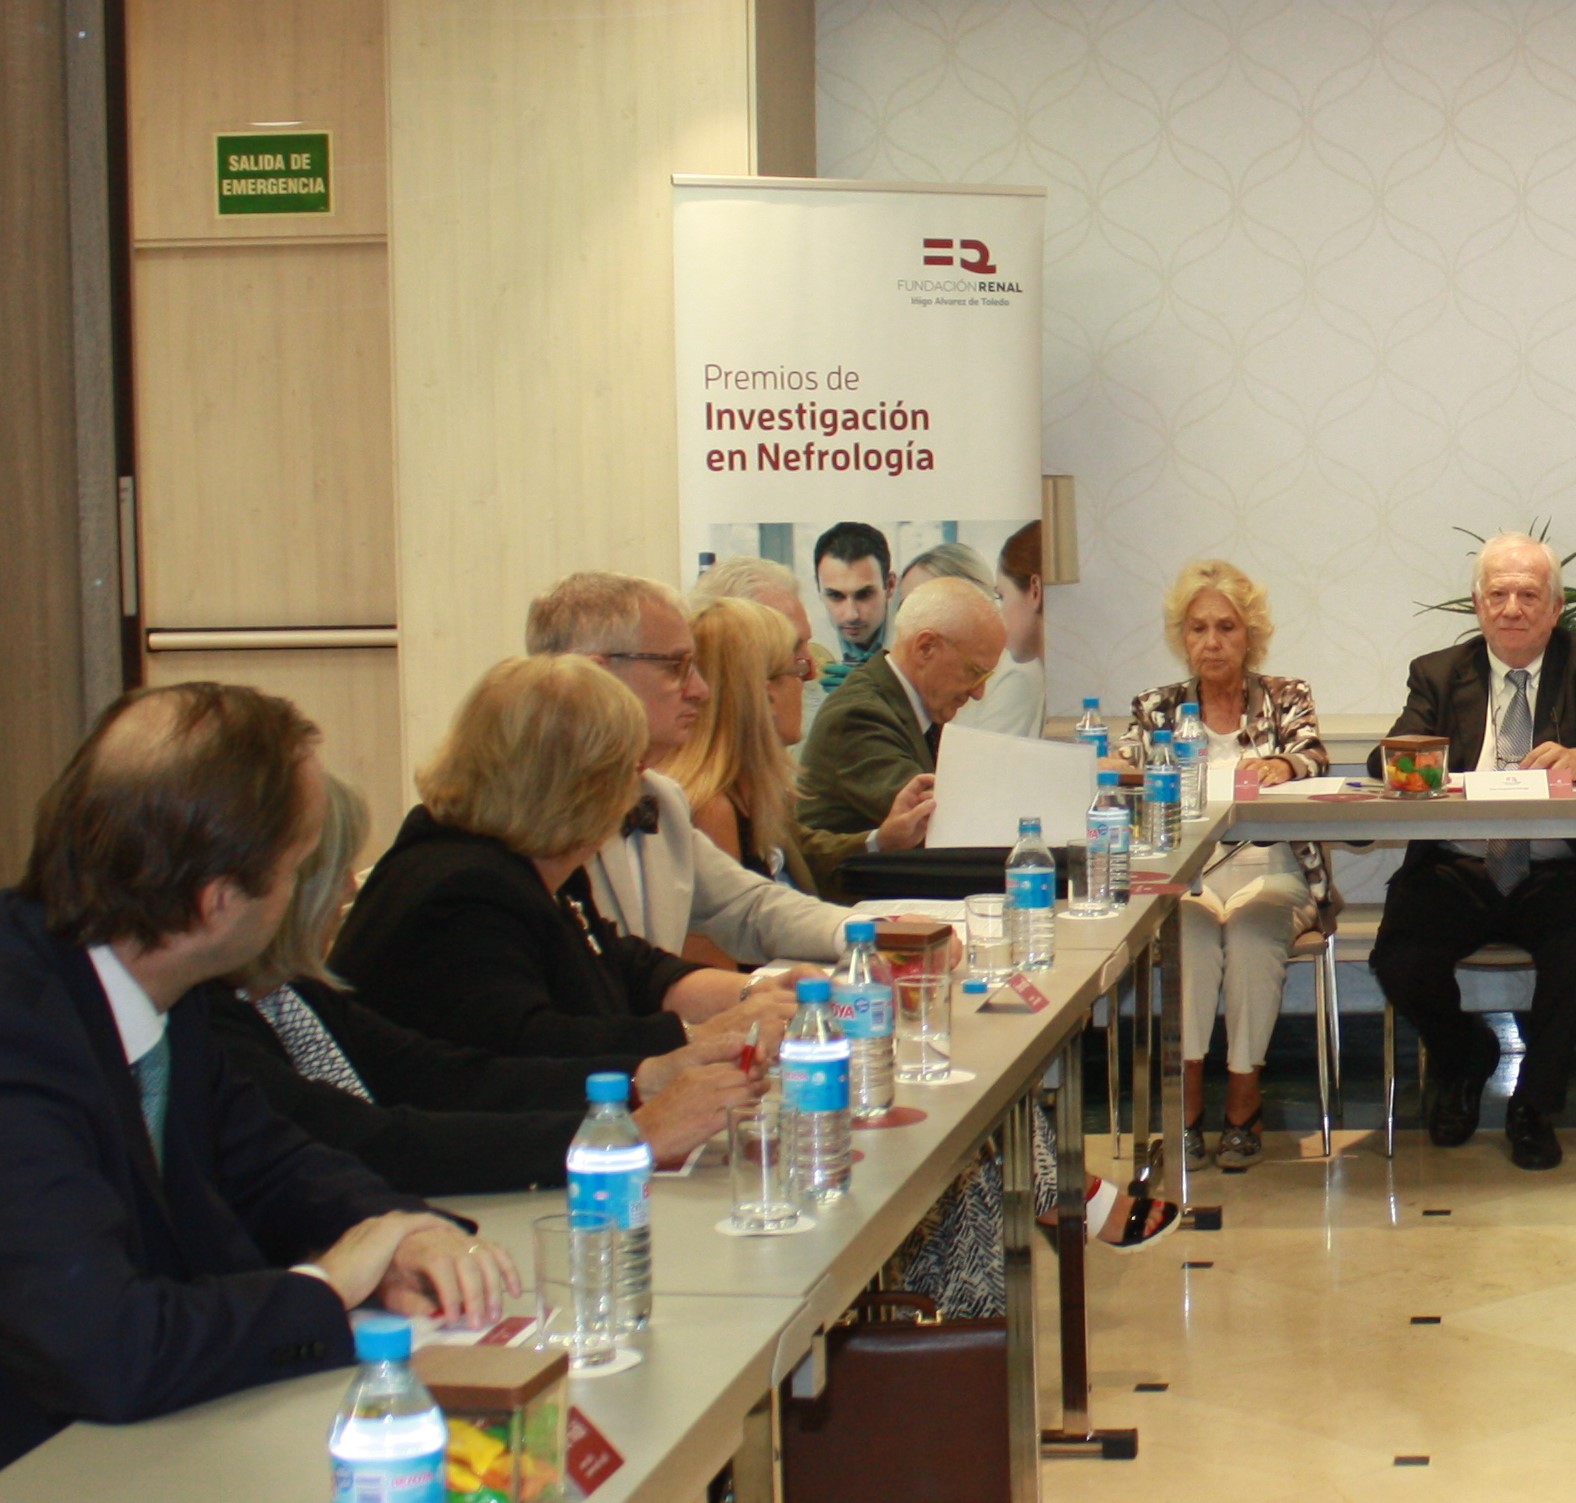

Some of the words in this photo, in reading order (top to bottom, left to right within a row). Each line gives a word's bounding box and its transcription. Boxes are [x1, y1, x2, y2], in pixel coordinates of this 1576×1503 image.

[228, 153, 286, 172] SALIDA
[290, 153, 311, 170] DE
[222, 177, 326, 196] EMERGENCIA
[968, 297, 980, 306] de
[981, 297, 1010, 307] Toledo
[704, 363, 818, 391] Premios
[826, 365, 860, 391] de
[705, 400, 930, 437] Investigación
[706, 448, 747, 472] en
[757, 440, 935, 477] Nefrología
